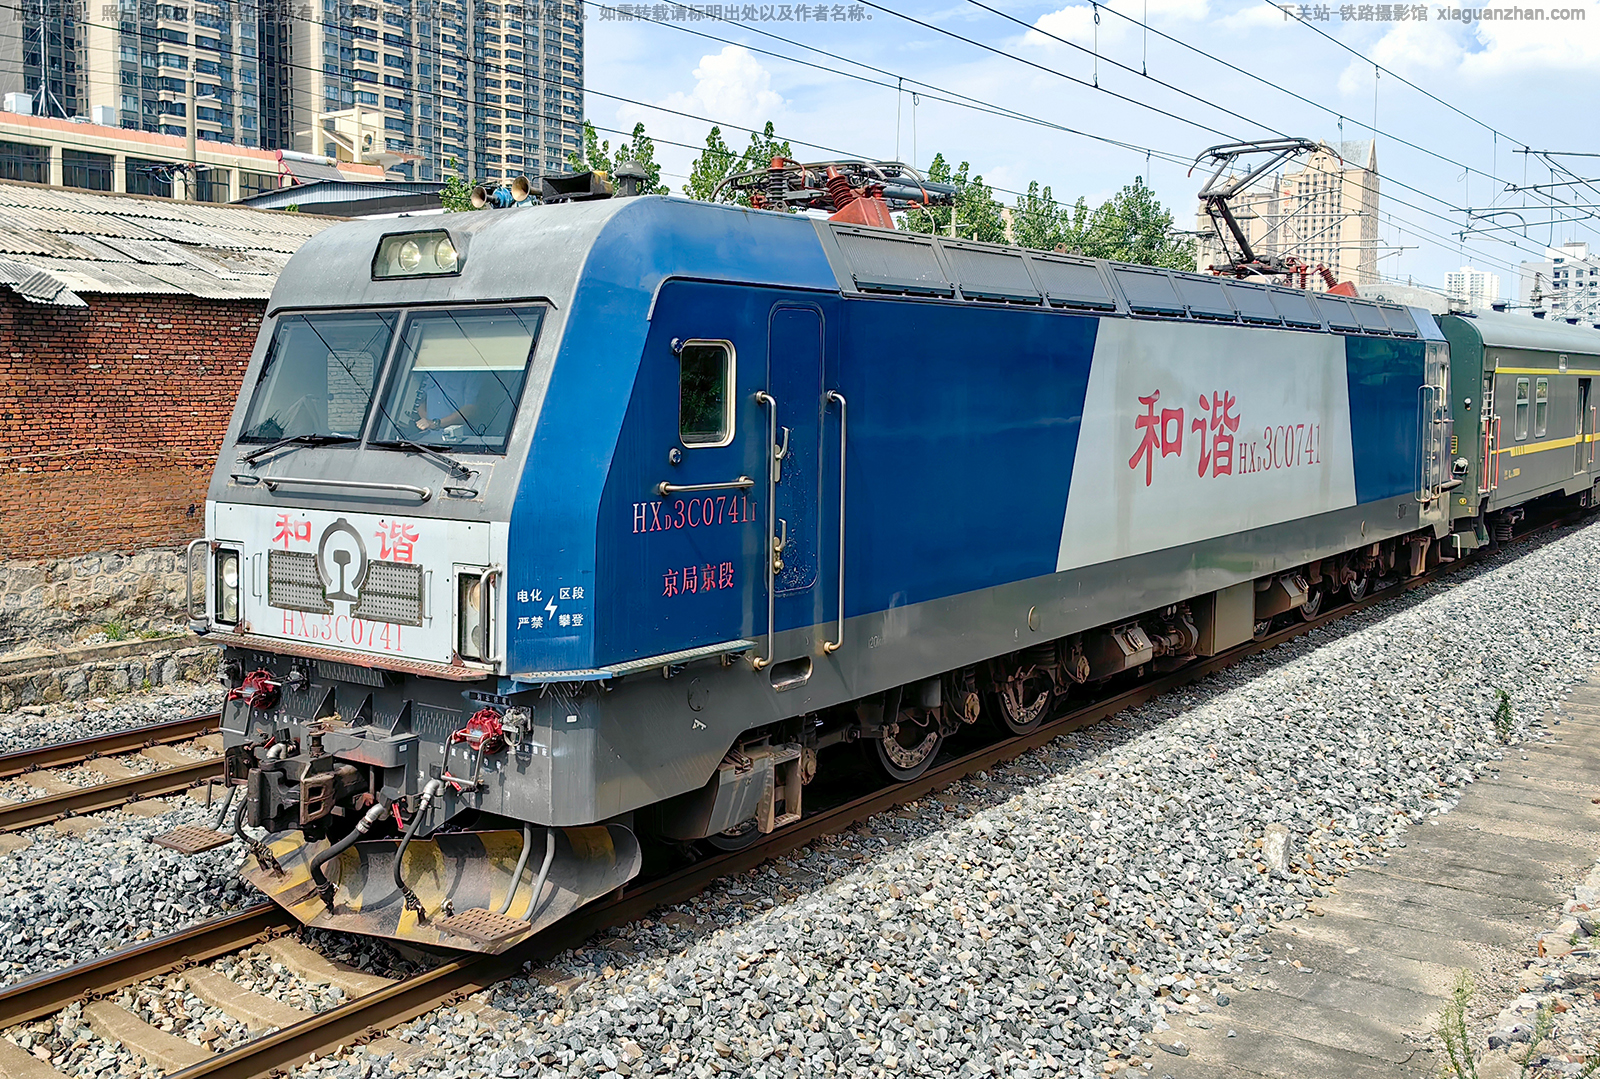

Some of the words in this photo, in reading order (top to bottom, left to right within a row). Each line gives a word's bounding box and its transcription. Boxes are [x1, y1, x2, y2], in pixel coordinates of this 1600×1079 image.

[1128, 388, 1241, 487] 和谐
[272, 513, 312, 550] 和
[375, 520, 420, 564] 谐
[517, 588, 543, 603] 电化
[559, 586, 585, 600] 区段
[662, 561, 734, 597] 京局京段
[516, 615, 543, 630] 严禁
[558, 613, 584, 628] 攀登
